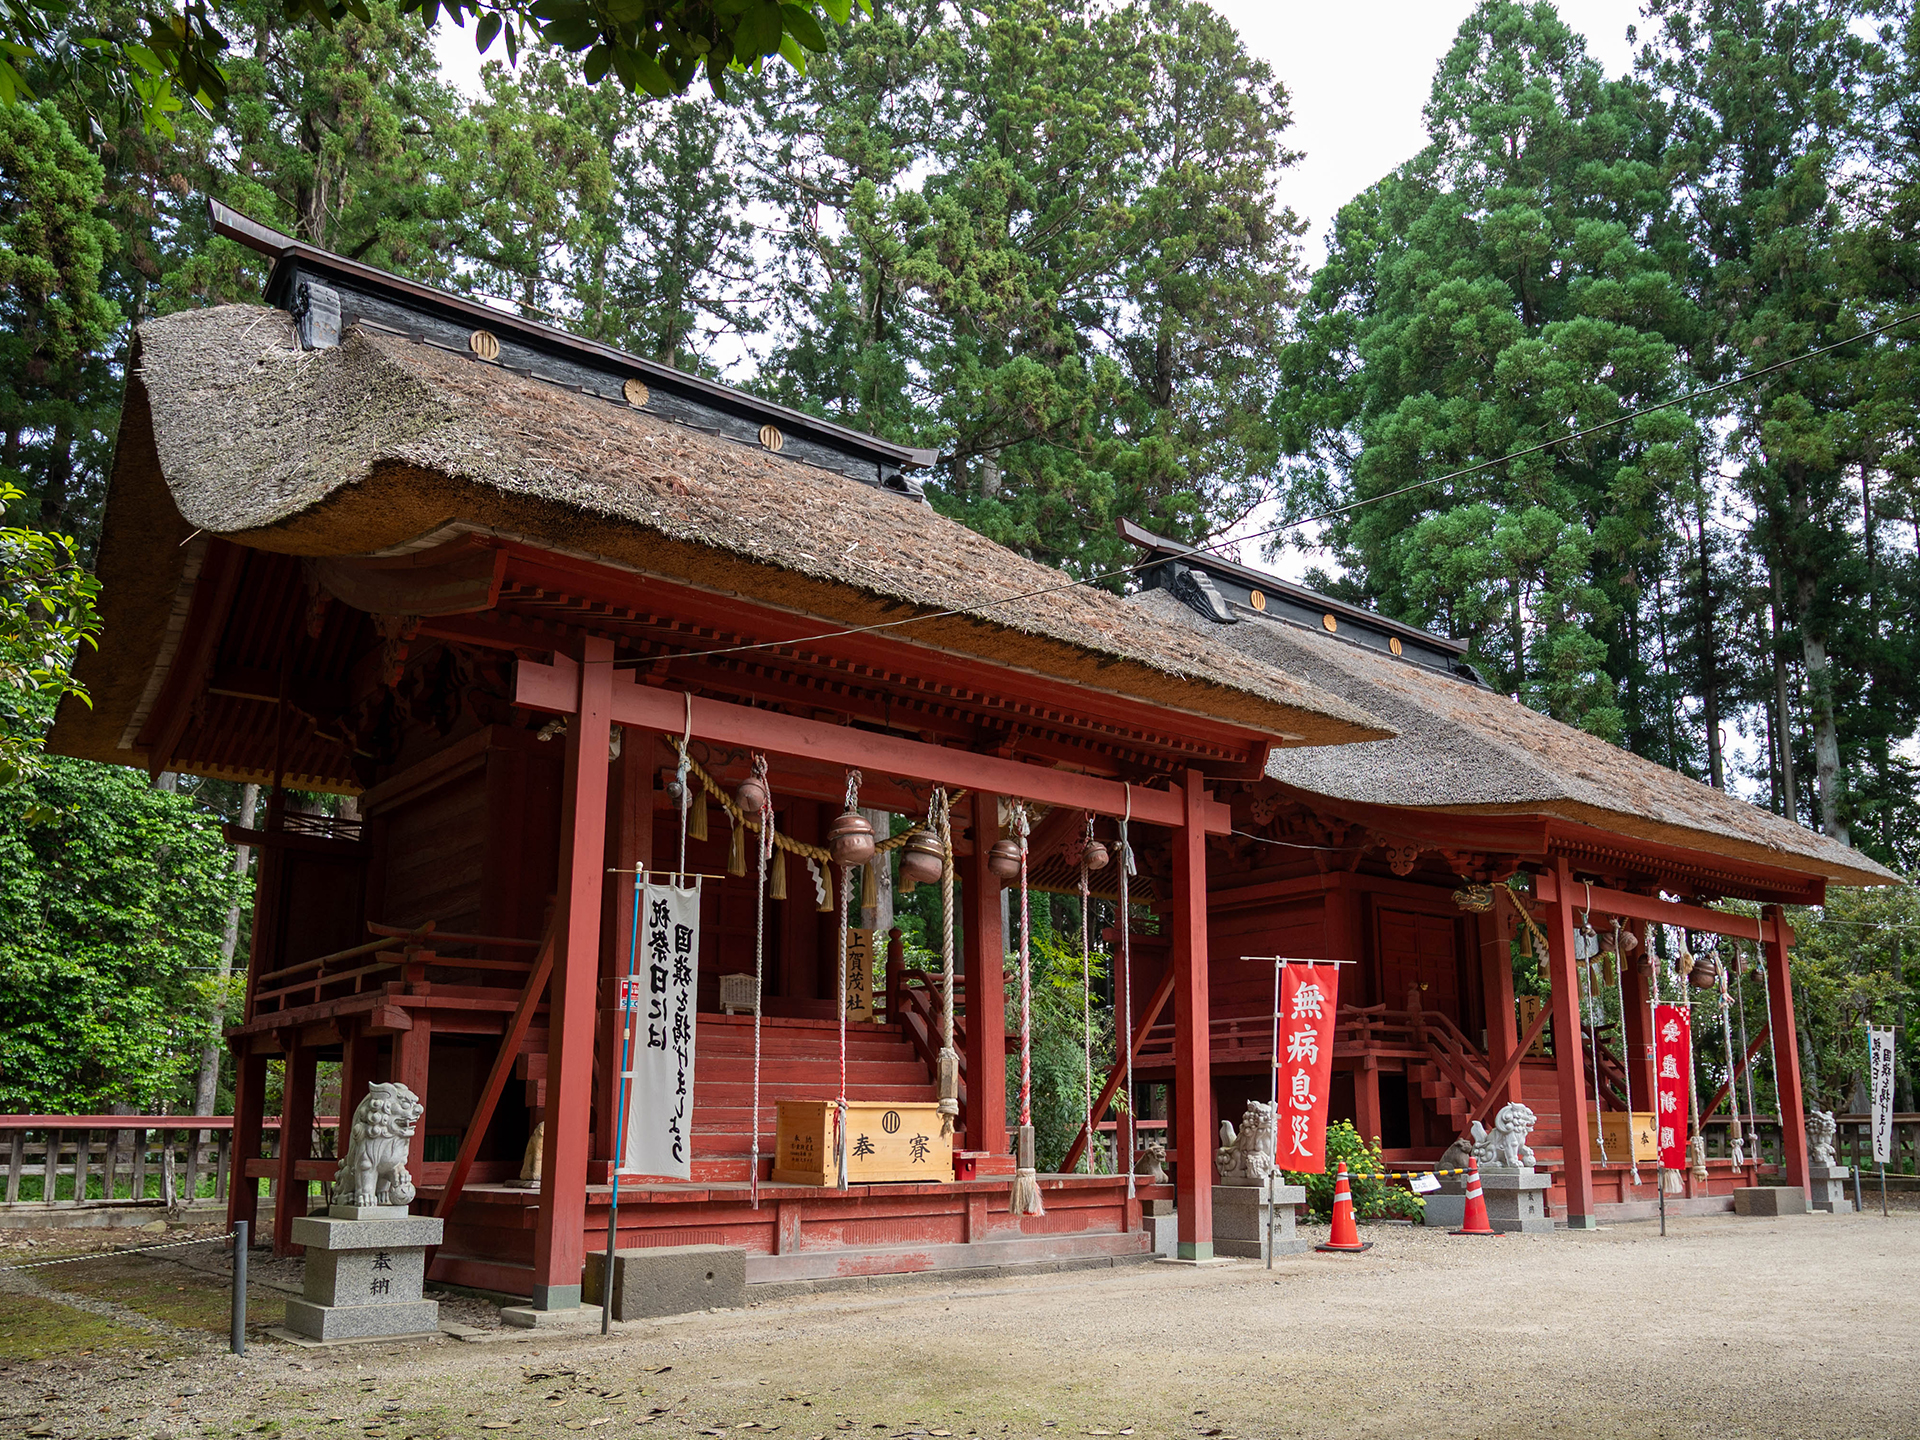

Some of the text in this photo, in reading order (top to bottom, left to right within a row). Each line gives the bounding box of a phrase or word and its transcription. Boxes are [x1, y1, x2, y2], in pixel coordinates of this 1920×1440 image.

[846, 932, 866, 1011] 上賀茂社
[1525, 998, 1539, 1050] 下賀社
[1286, 981, 1325, 1157] 無病息災
[852, 1133, 931, 1163] 奉 賽
[370, 1251, 393, 1295] 奉納
